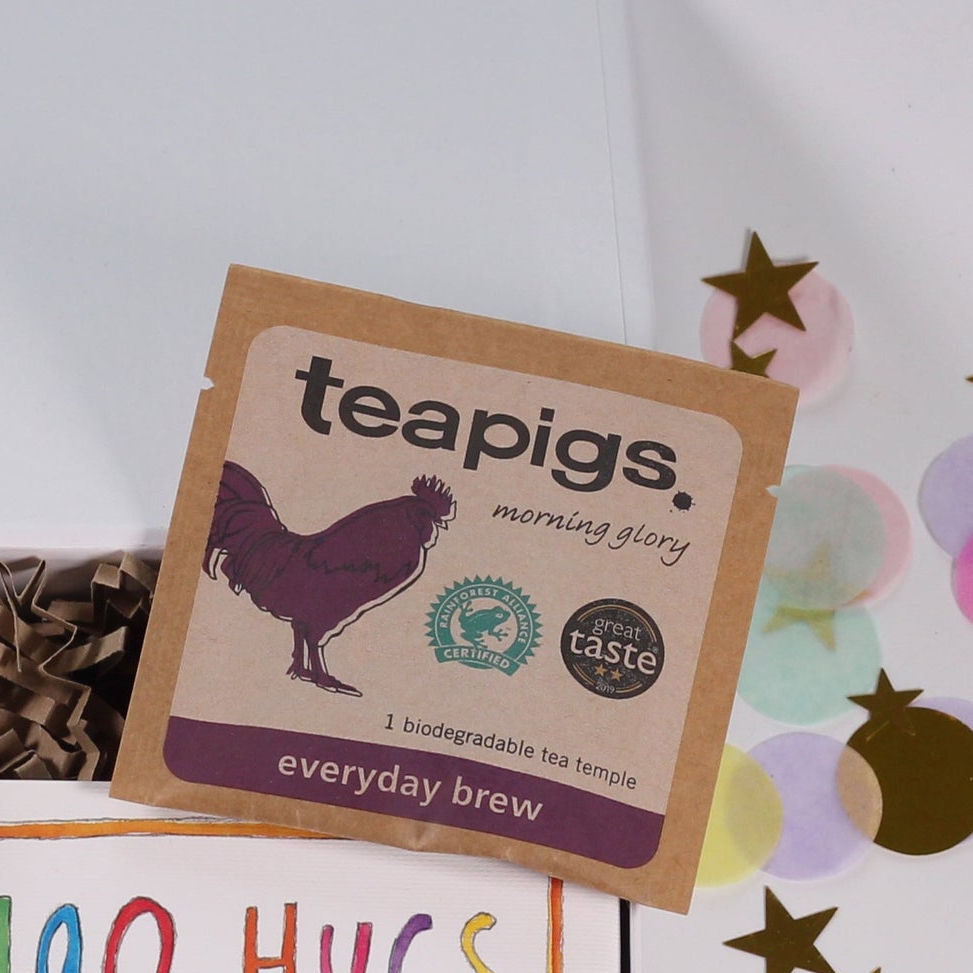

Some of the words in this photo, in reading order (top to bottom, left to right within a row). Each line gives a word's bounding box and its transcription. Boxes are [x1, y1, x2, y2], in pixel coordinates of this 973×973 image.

[295, 356, 695, 513] teapigs.
[492, 504, 611, 546] morning
[608, 524, 691, 566] glory
[440, 588, 499, 629] RAINFOREST
[502, 594, 529, 643] ALLIANCE
[592, 618, 642, 641] great
[444, 648, 511, 669] CERTIFIED
[569, 629, 657, 675] taste
[595, 683, 615, 694] 2019
[384, 713, 395, 730] 1
[402, 717, 535, 759] biodegradable
[541, 747, 569, 769] tea
[575, 757, 638, 790] temple
[278, 754, 442, 807] everyday
[452, 776, 543, 821] brew
